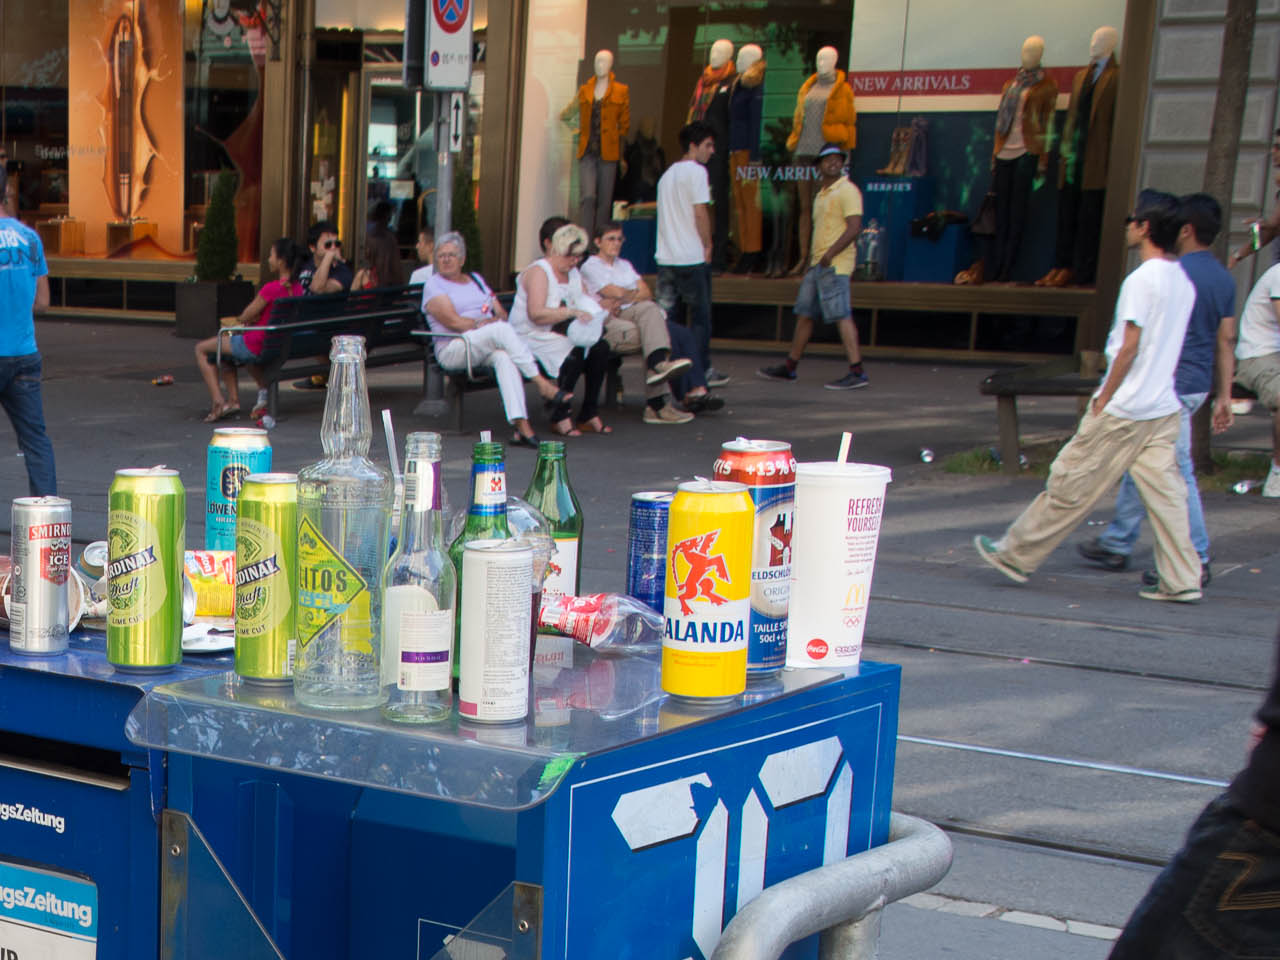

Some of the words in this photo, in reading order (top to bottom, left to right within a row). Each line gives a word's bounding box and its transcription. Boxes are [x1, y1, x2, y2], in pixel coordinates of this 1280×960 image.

[853, 77, 890, 91] NEW
[891, 75, 972, 91] ARRIVALS
[736, 166, 772, 181] NEW
[773, 165, 850, 181] ARRIVS
[207, 500, 237, 515] LÖWEN
[49, 556, 69, 566] ICE
[111, 617, 127, 625] LIME
[664, 617, 745, 644] ALANDA
